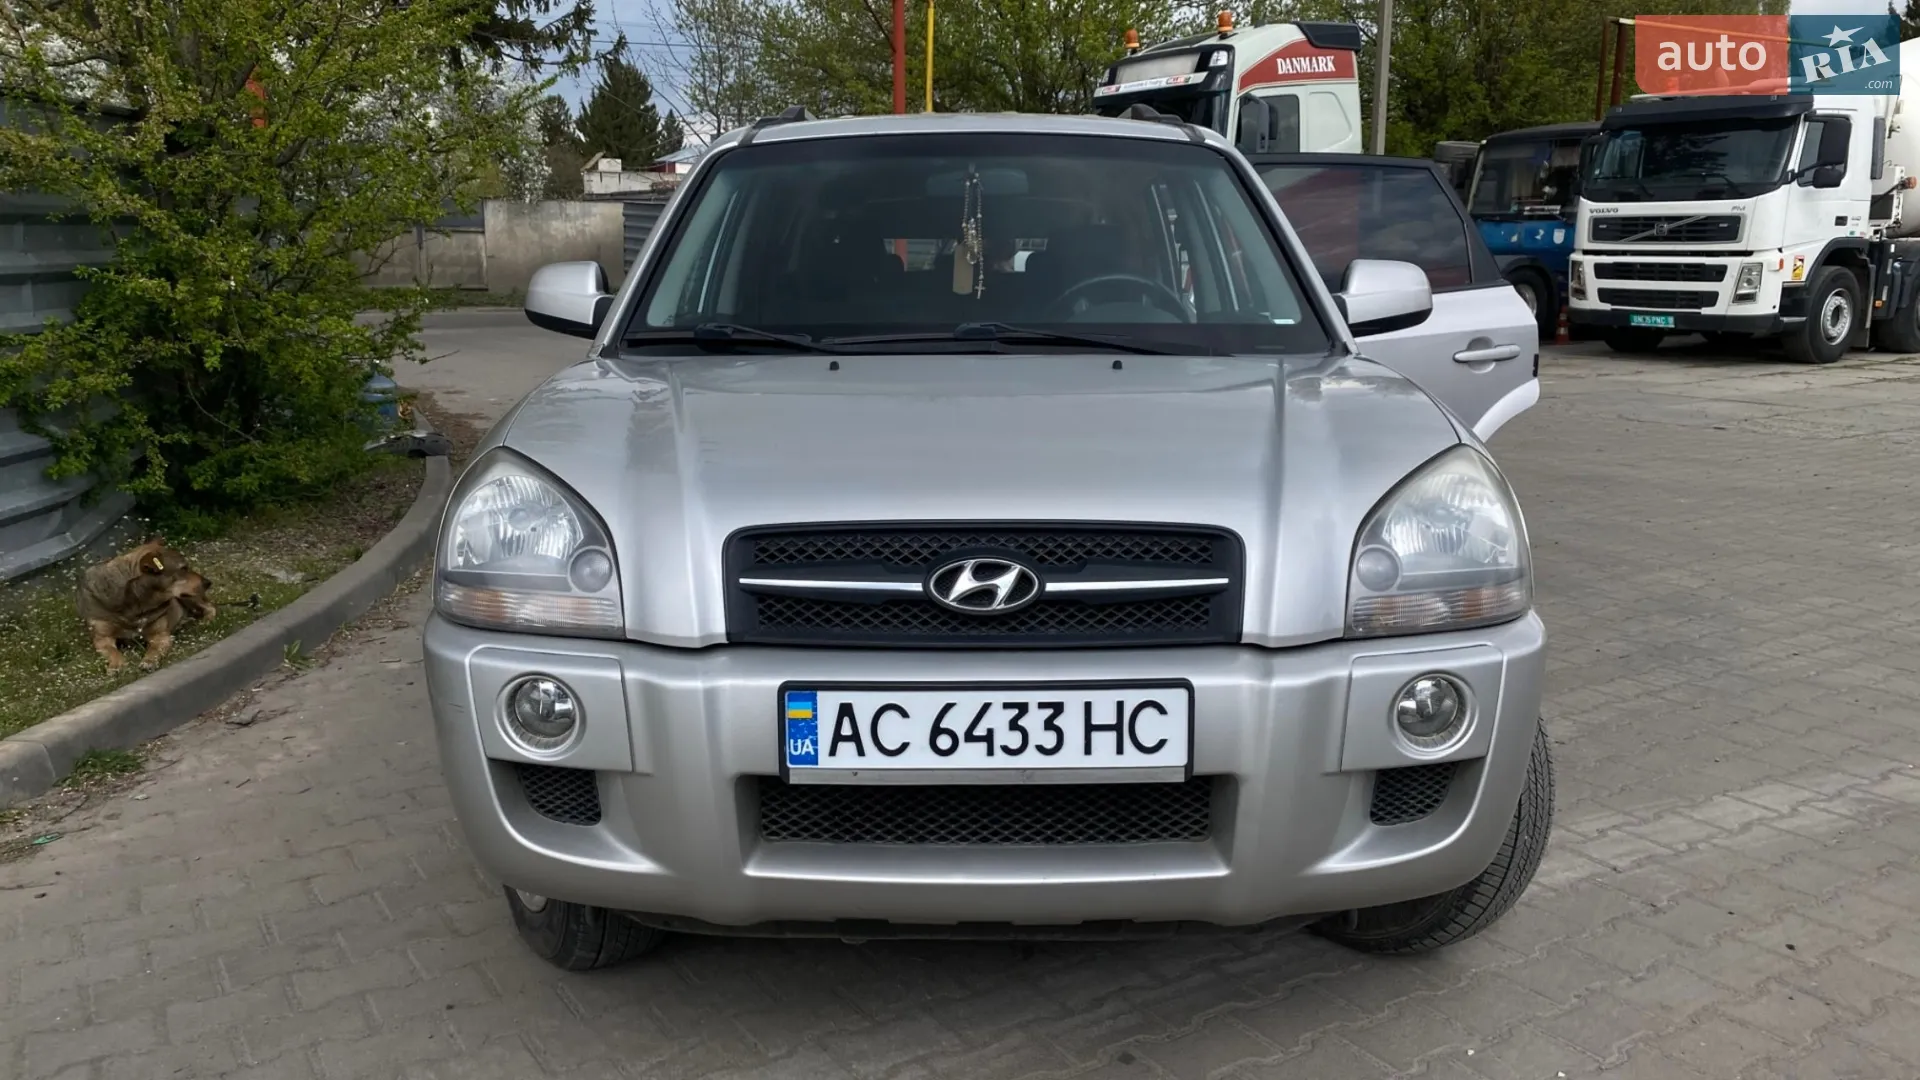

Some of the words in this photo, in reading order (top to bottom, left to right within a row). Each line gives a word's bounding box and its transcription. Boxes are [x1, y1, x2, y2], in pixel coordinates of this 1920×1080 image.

[1276, 55, 1336, 75] DANMARK
[828, 702, 911, 757] AC
[929, 701, 1064, 757] 6433
[1083, 700, 1168, 756] HC
[790, 738, 816, 756] UA
